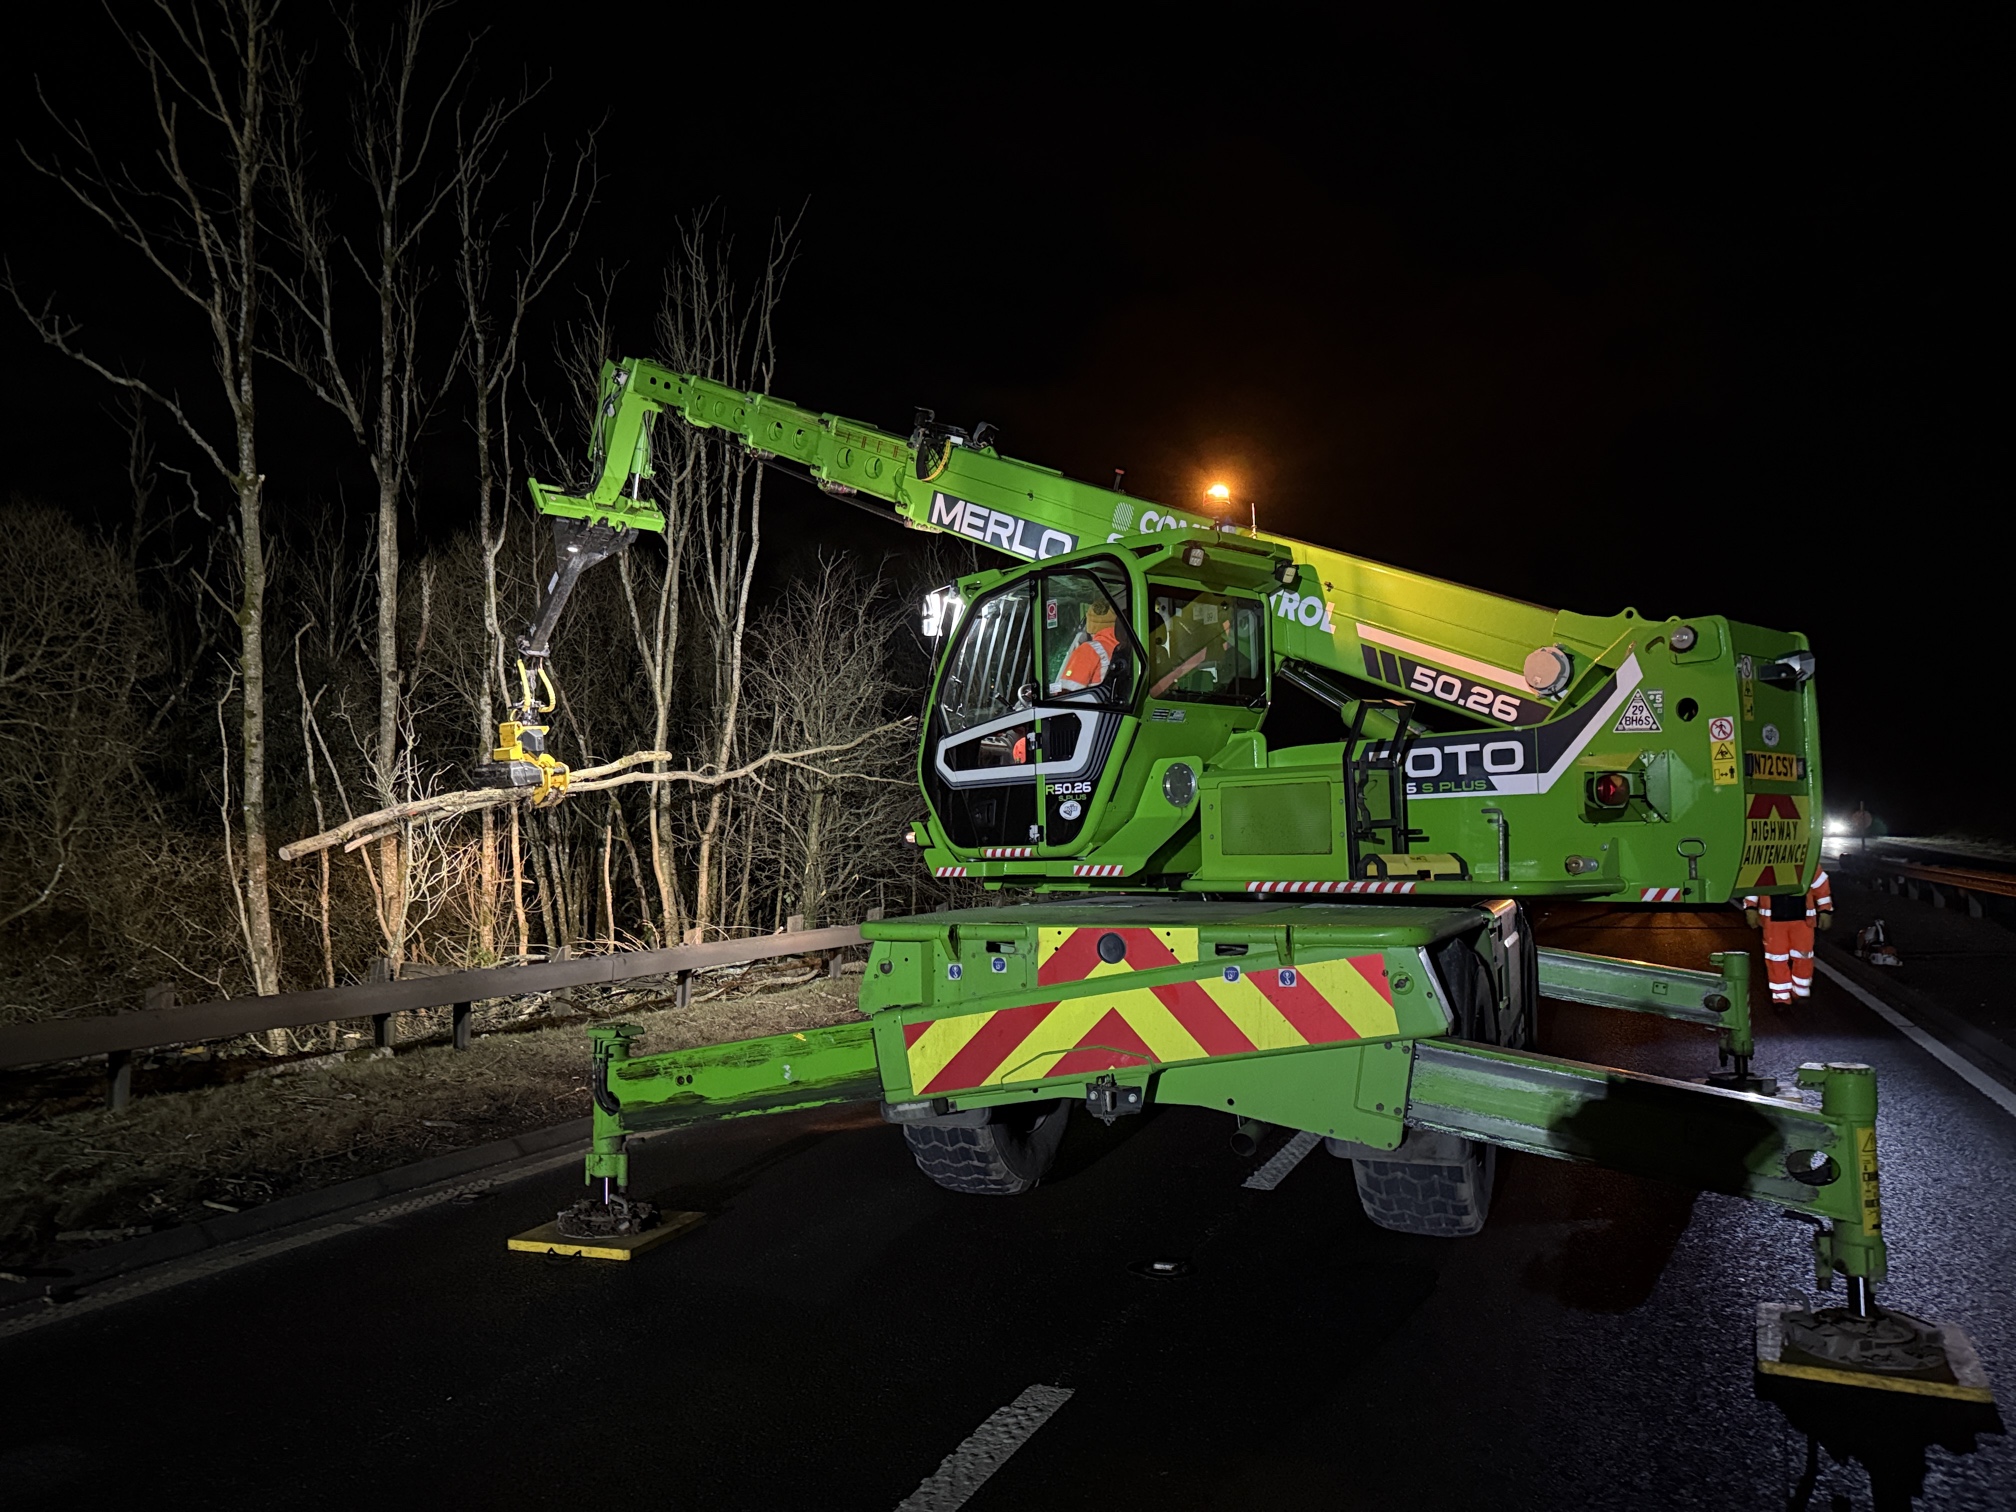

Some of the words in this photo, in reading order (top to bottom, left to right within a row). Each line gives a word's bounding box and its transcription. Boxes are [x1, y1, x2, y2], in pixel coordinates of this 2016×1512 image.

[931, 493, 1073, 561] MERLO
[1410, 665, 1521, 722] 50.26
[1632, 705, 1644, 716] 29
[1624, 716, 1651, 726] BH6S
[1369, 740, 1524, 778] OTO
[1045, 782, 1091, 795] R50.26
[1422, 783, 1433, 793] S
[1439, 780, 1487, 792] PLUS
[1751, 821, 1798, 841] HIGHWAY
[1743, 843, 1806, 865] AINTENANCE
